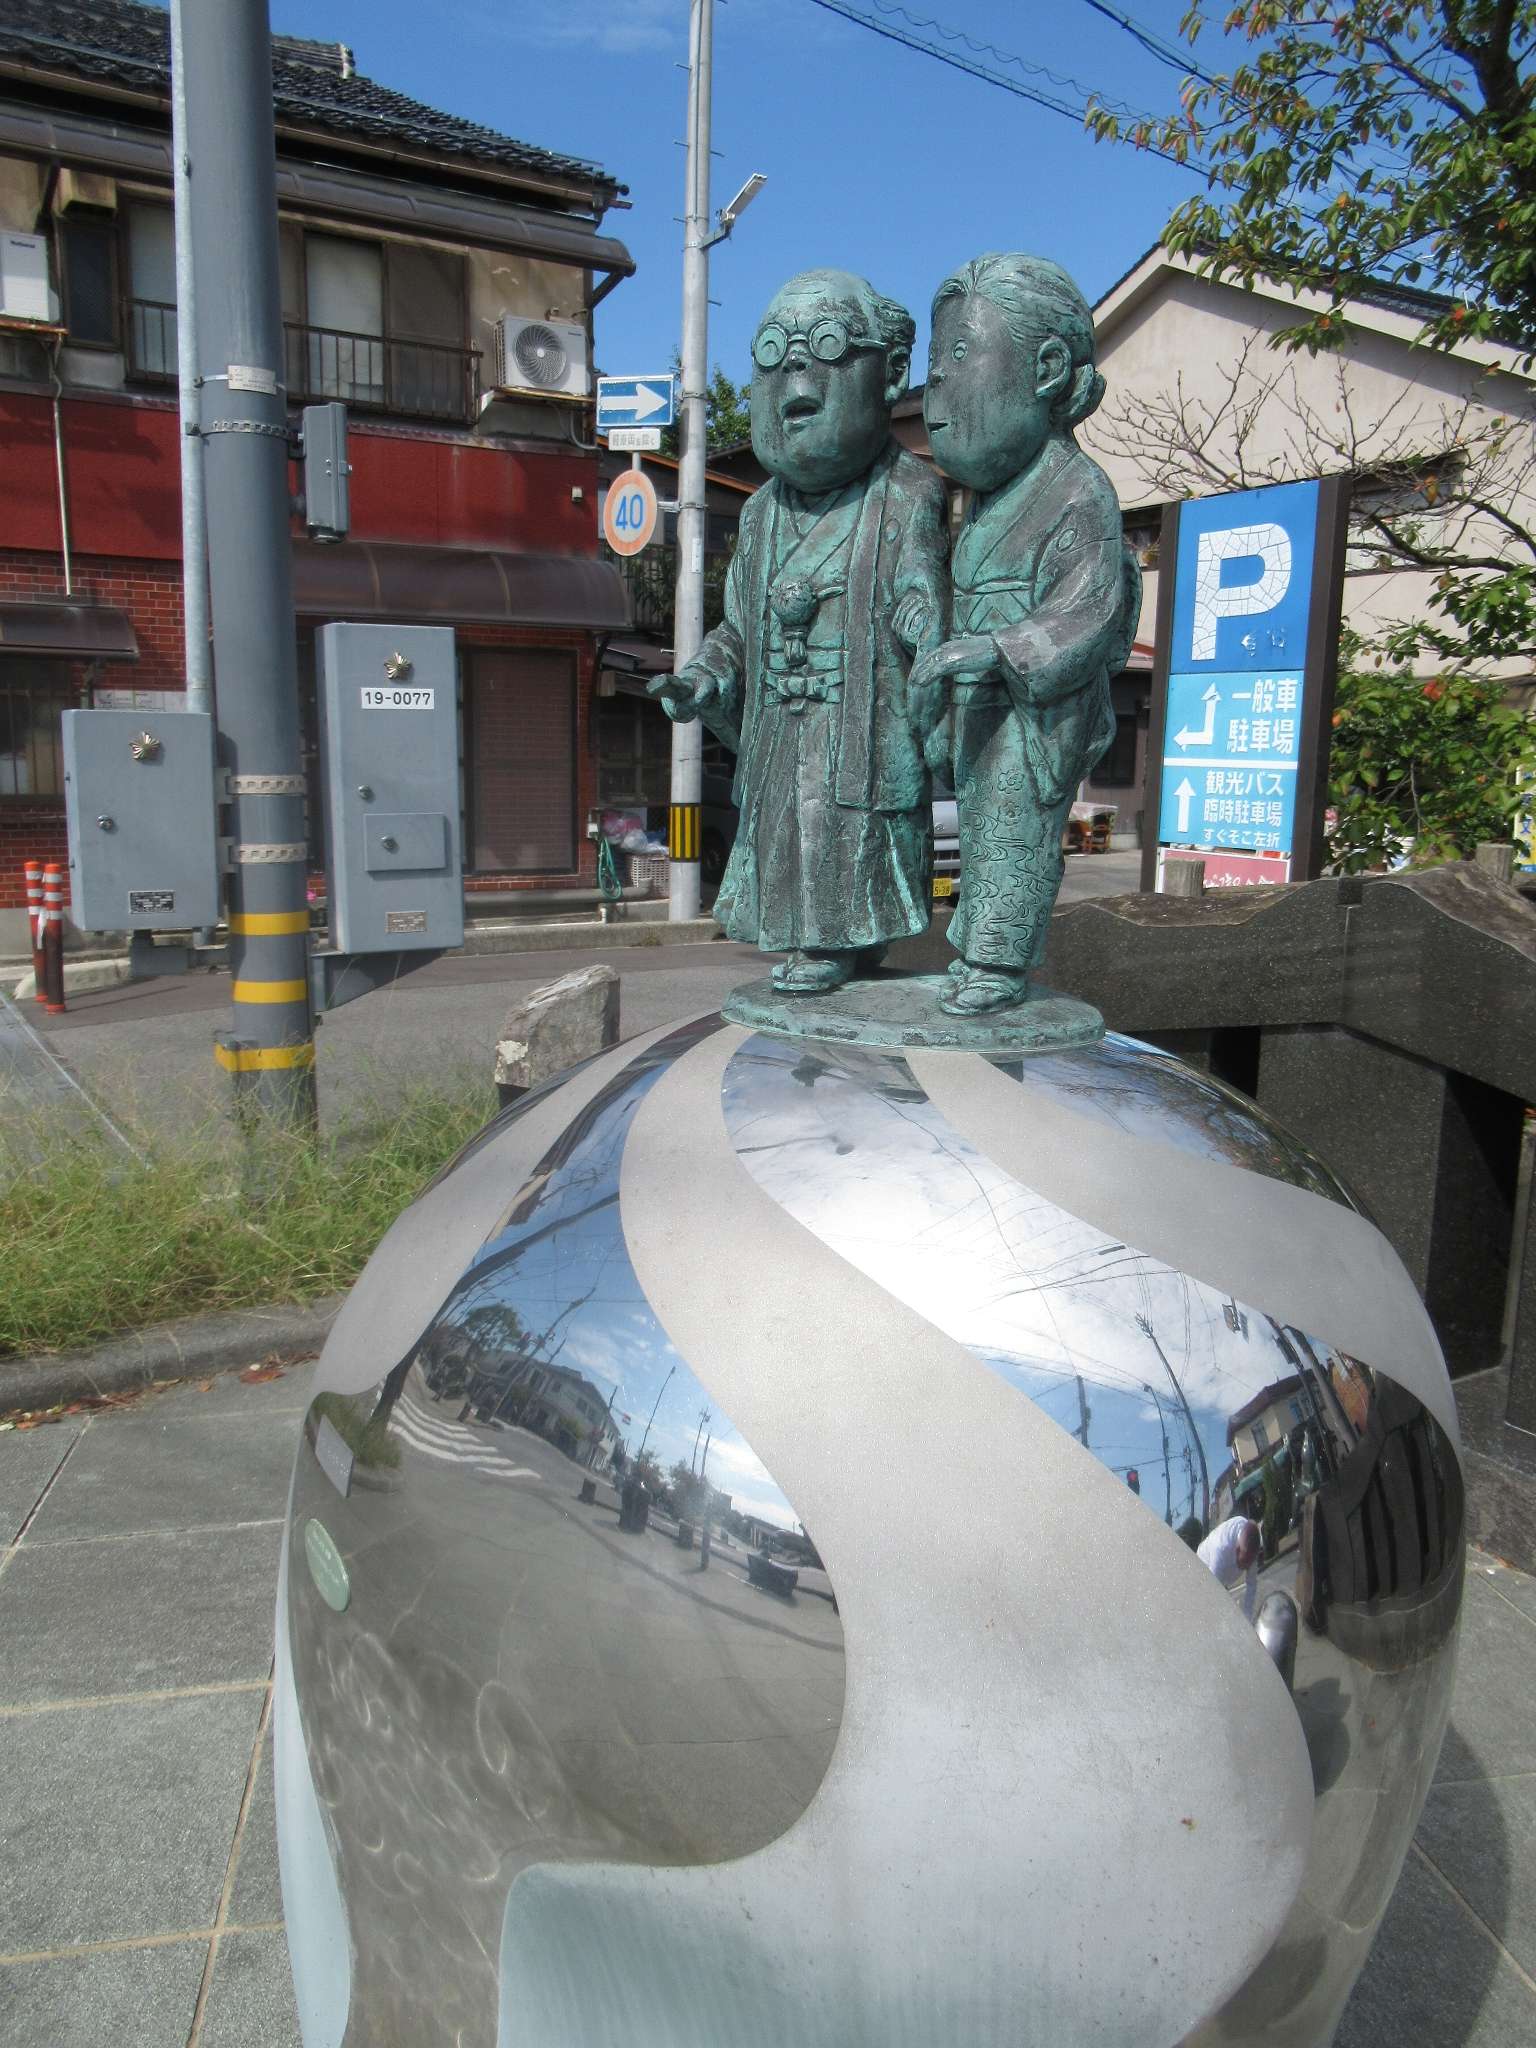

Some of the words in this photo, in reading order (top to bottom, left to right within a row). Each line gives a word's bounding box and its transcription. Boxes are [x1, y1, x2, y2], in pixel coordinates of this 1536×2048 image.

[615, 494, 645, 530] 40
[1191, 522, 1293, 662] P
[364, 691, 431, 705] 19-0077
[1231, 679, 1298, 714] 一般車
[1226, 718, 1295, 755] 駐車場
[1205, 770, 1285, 797] 観光バス
[1202, 799, 1283, 828] 臨時駐車場
[1202, 828, 1281, 849] すぐそこ左折
